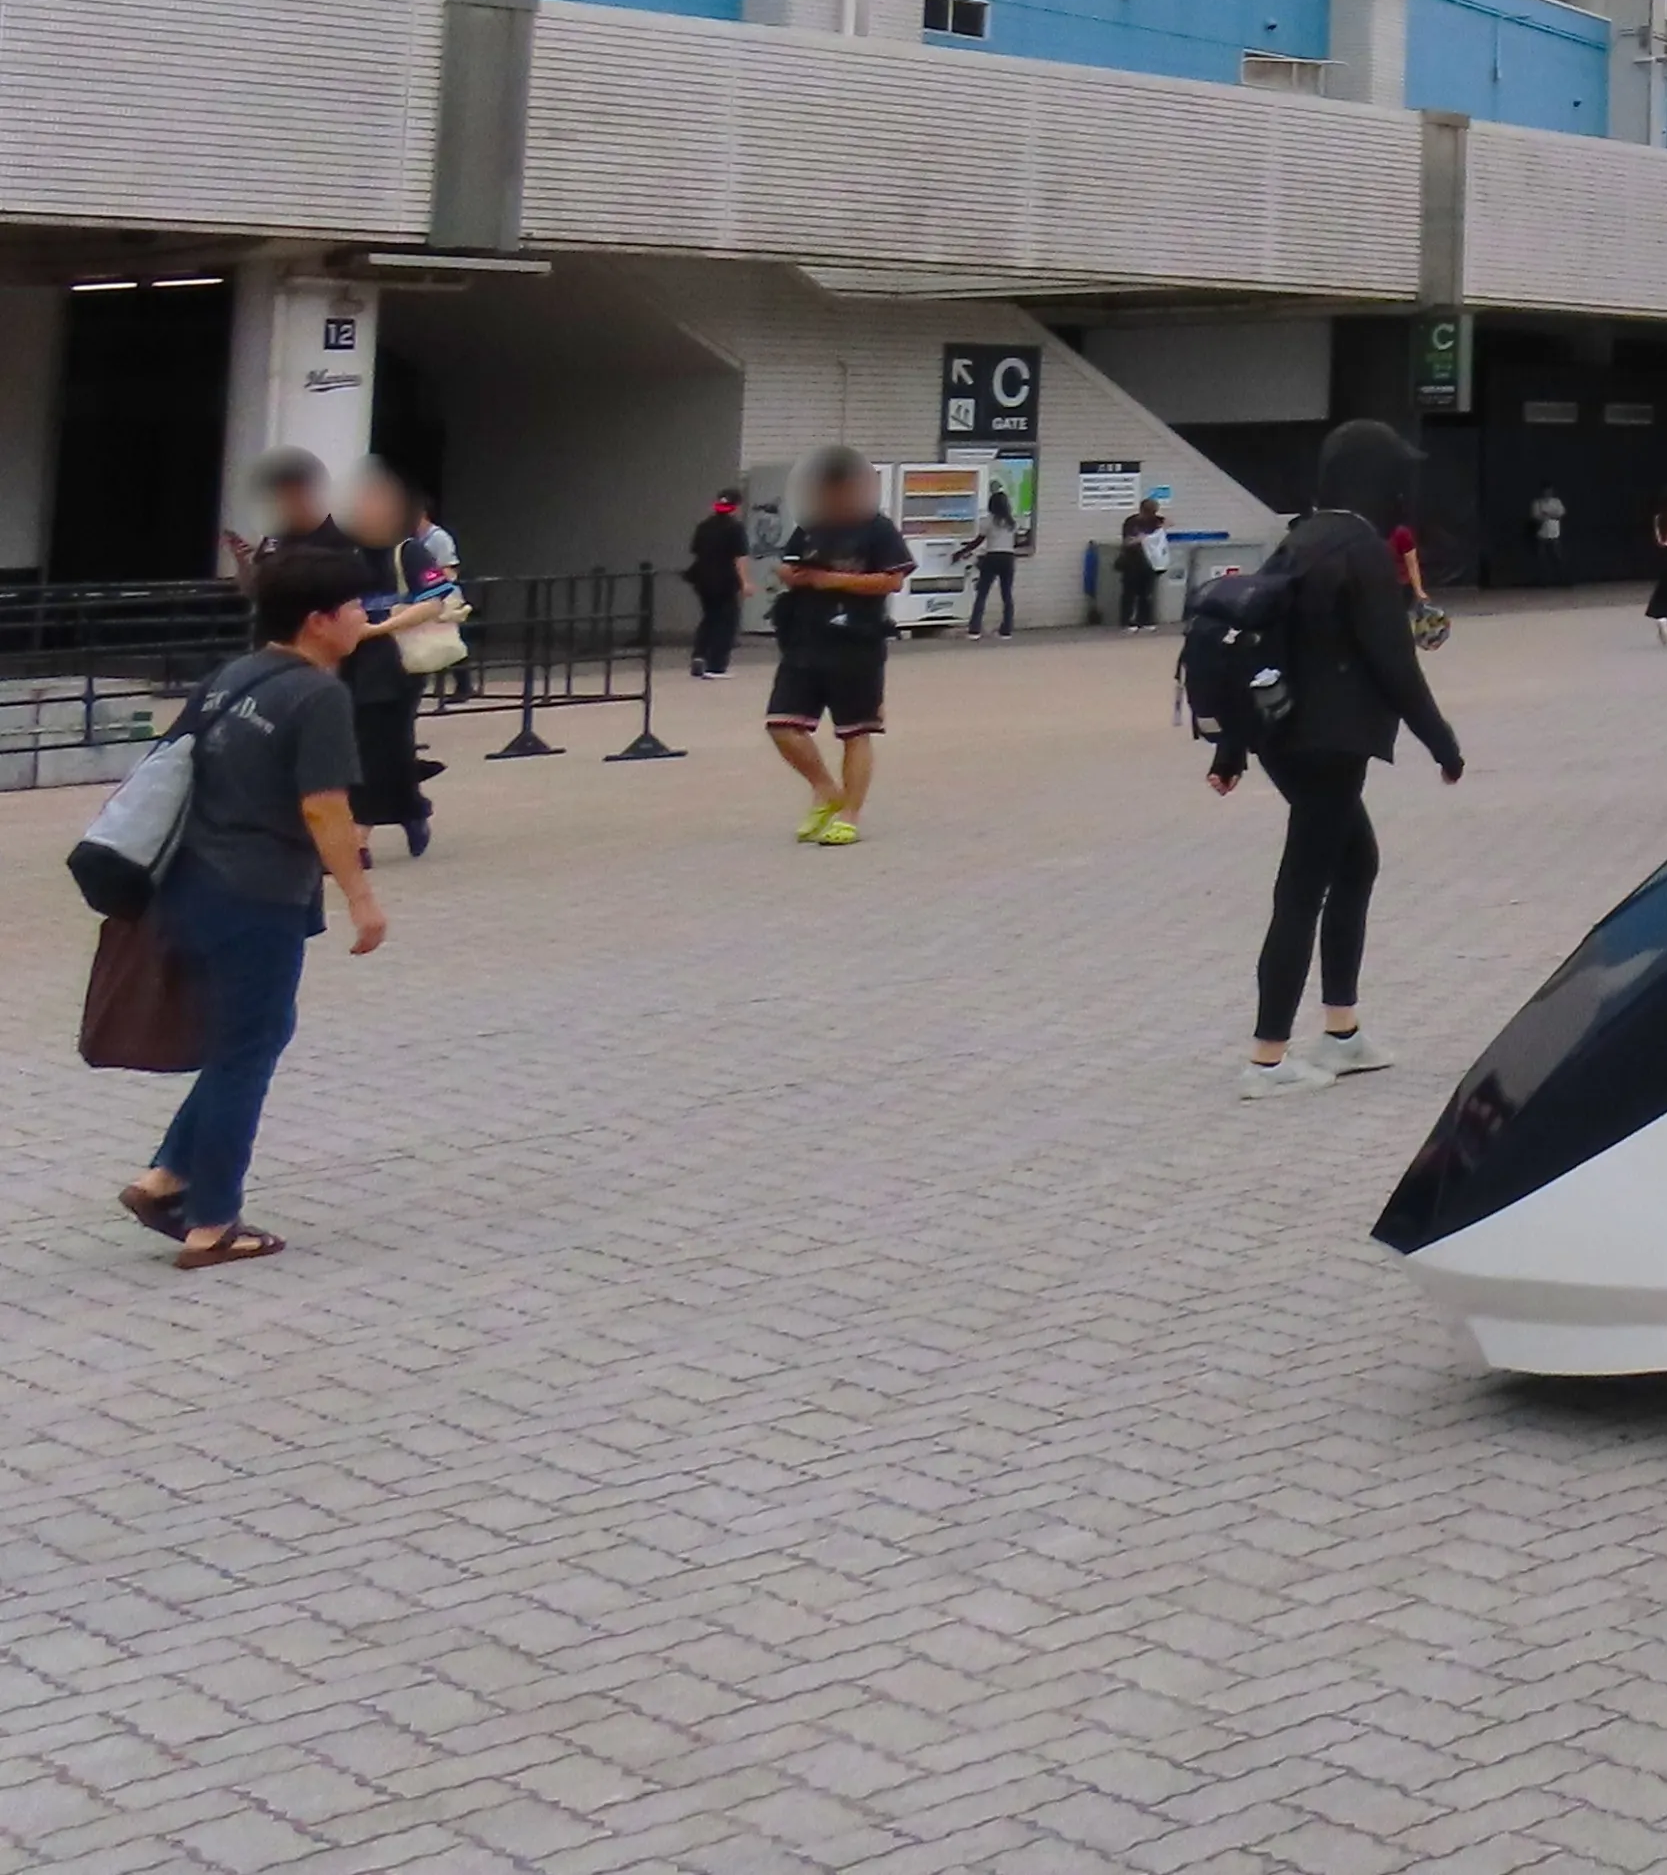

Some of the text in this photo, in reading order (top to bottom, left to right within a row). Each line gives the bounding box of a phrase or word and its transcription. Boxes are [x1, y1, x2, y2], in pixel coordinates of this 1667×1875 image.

[327, 324, 353, 344] 12
[1432, 323, 1454, 350] C
[992, 357, 1030, 407] C
[991, 417, 1028, 430] GATE
